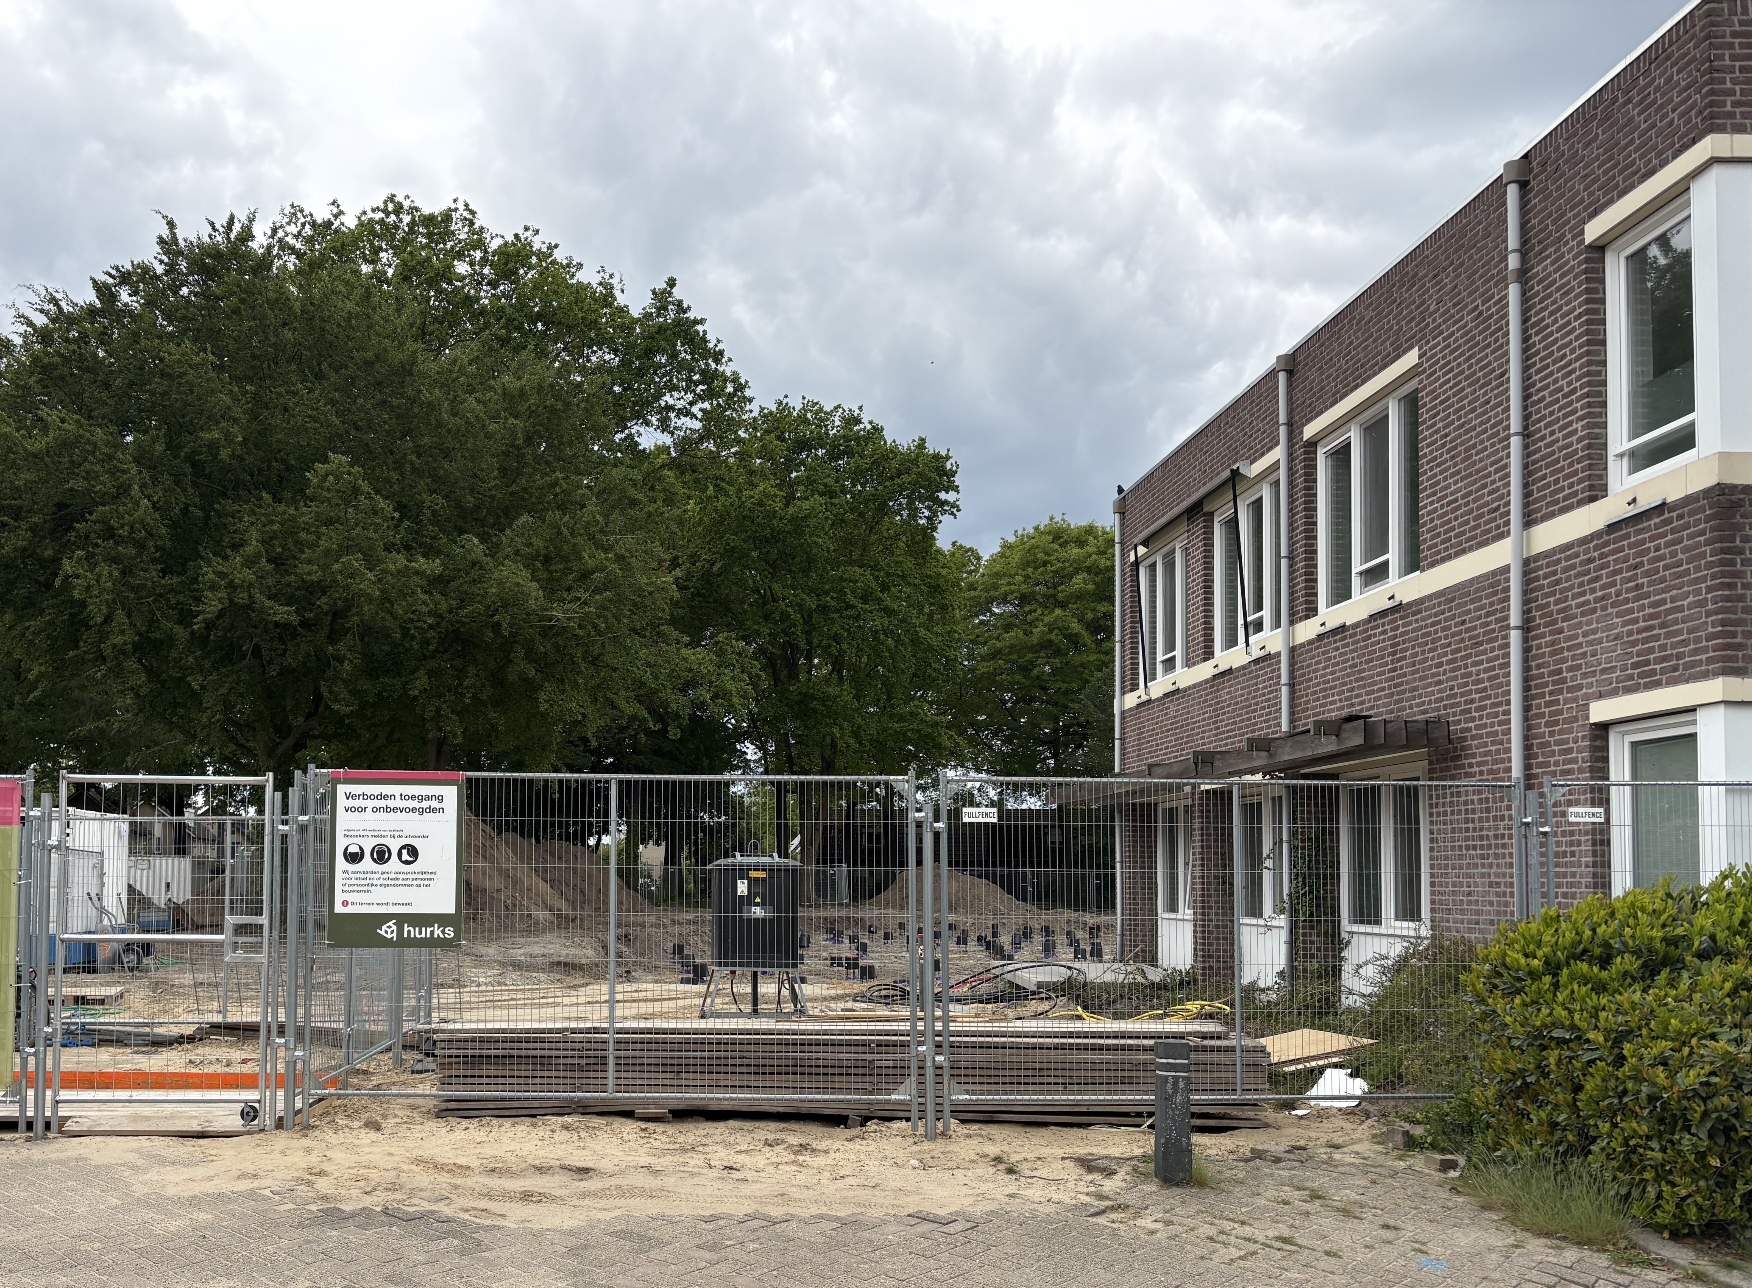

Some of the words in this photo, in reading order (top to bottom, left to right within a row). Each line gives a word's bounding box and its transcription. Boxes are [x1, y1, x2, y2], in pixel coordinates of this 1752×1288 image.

[344, 792, 396, 800] Verboden
[400, 792, 444, 803] toegang
[372, 805, 444, 815] onbevoegden
[404, 923, 454, 938] hurks
